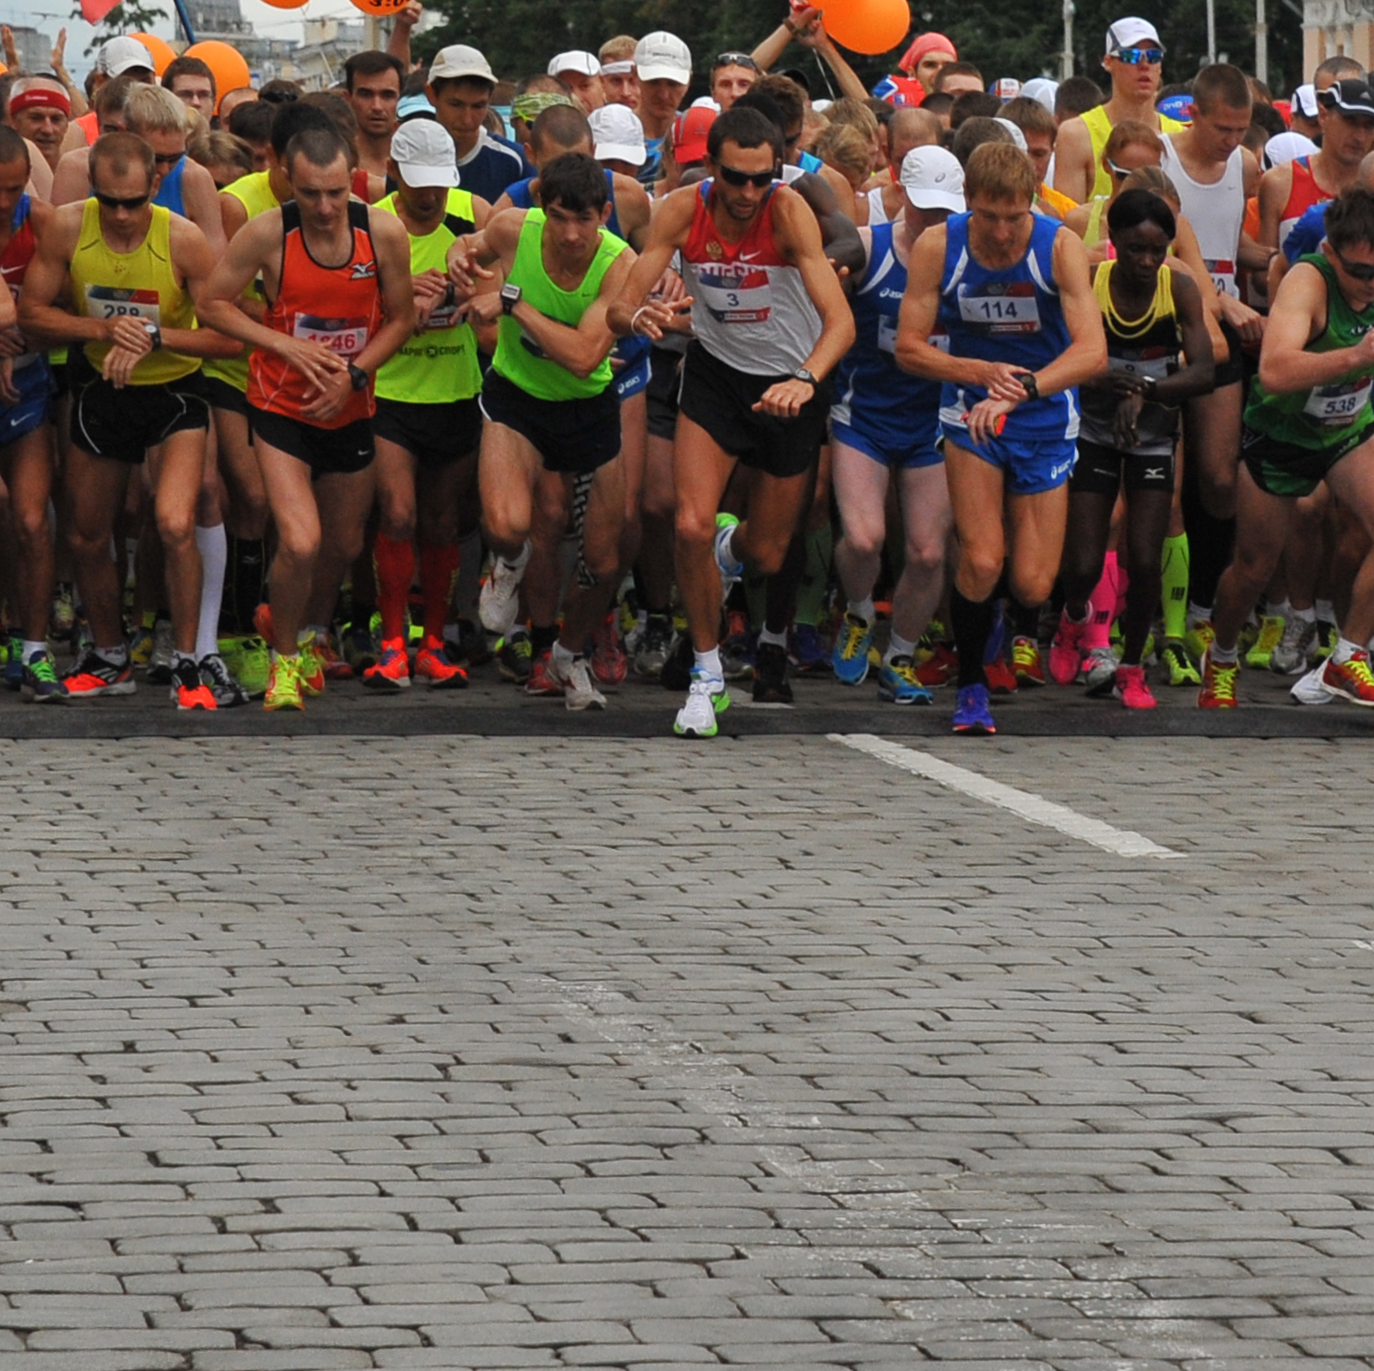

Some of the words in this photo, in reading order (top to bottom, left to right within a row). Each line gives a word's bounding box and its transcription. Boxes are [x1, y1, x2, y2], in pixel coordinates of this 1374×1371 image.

[726, 292, 740, 307] 3
[980, 301, 1018, 319] 114
[1324, 397, 1357, 414] 538
